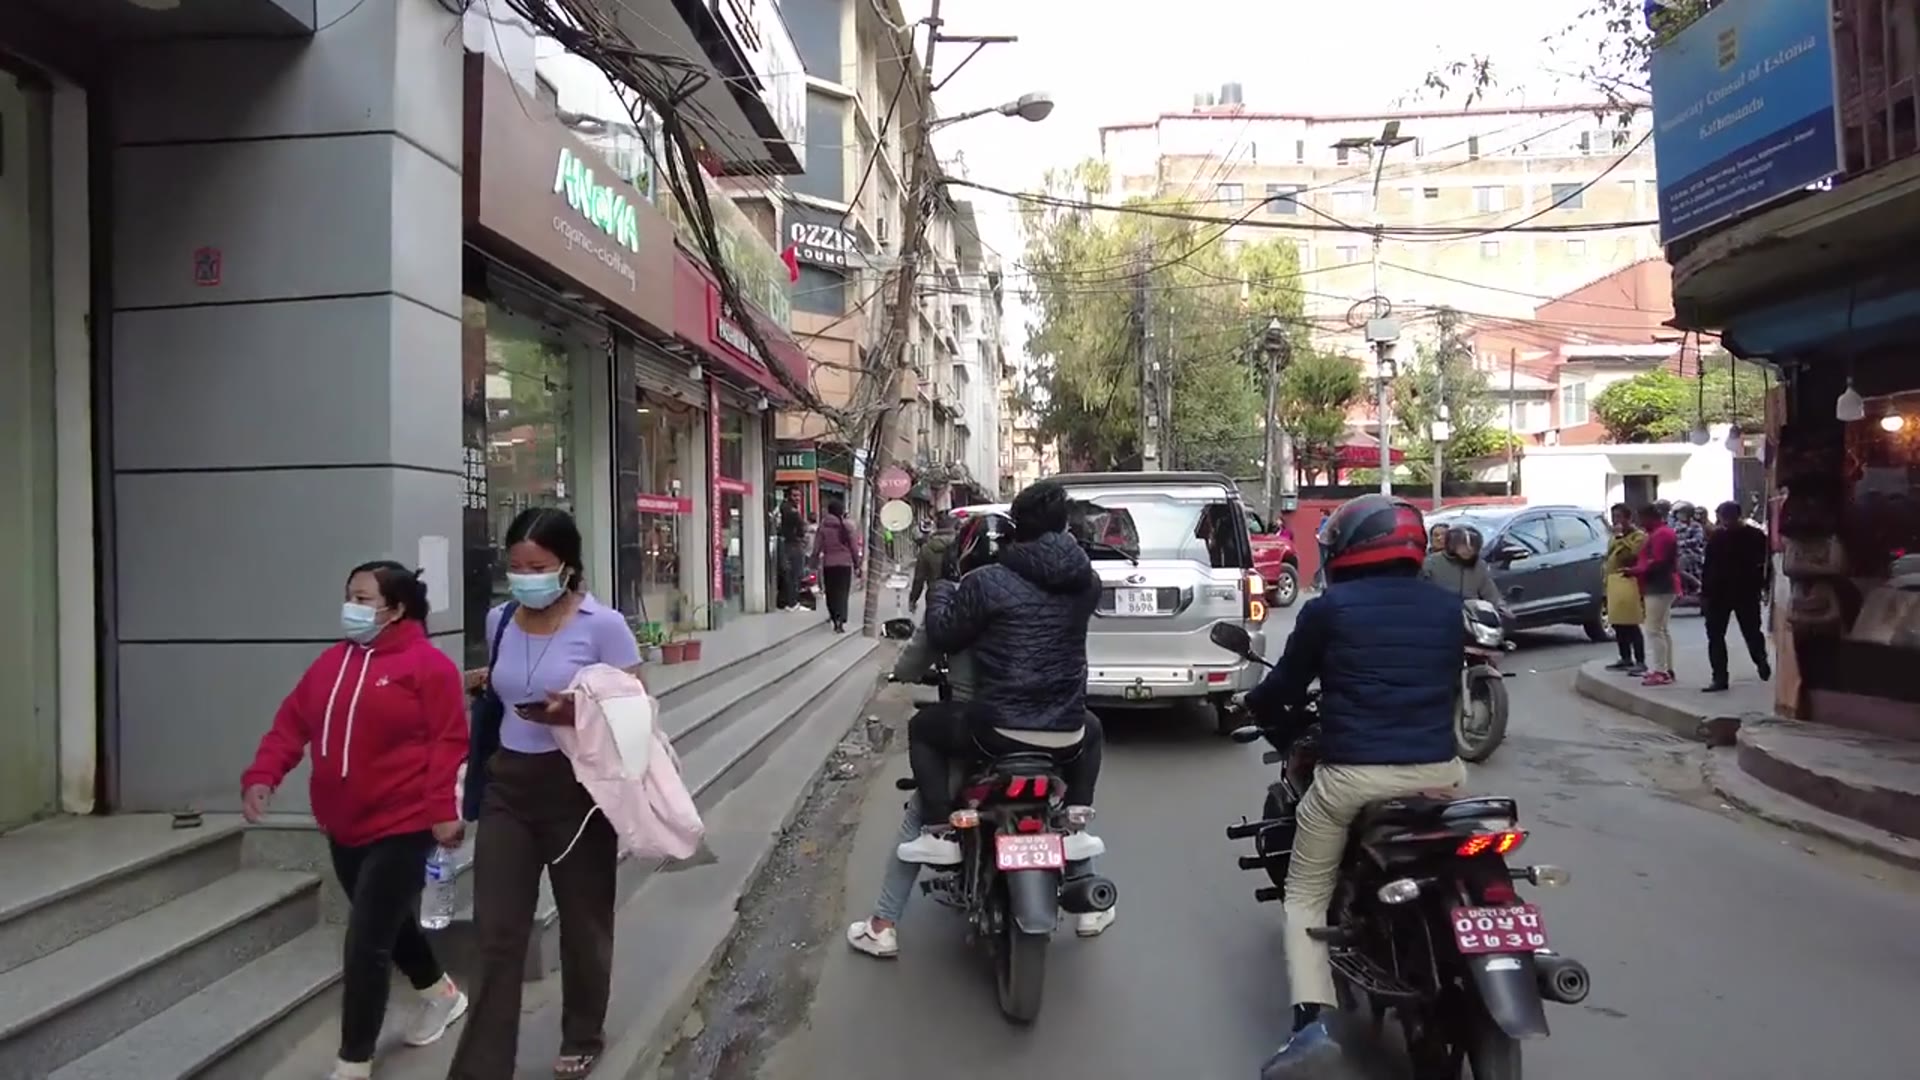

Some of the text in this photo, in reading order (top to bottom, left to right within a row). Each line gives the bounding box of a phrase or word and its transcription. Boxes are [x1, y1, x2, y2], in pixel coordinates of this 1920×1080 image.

[1748, 60, 1761, 82] of
[1764, 36, 1816, 74] Estonia
[878, 478, 908, 489] STOP
